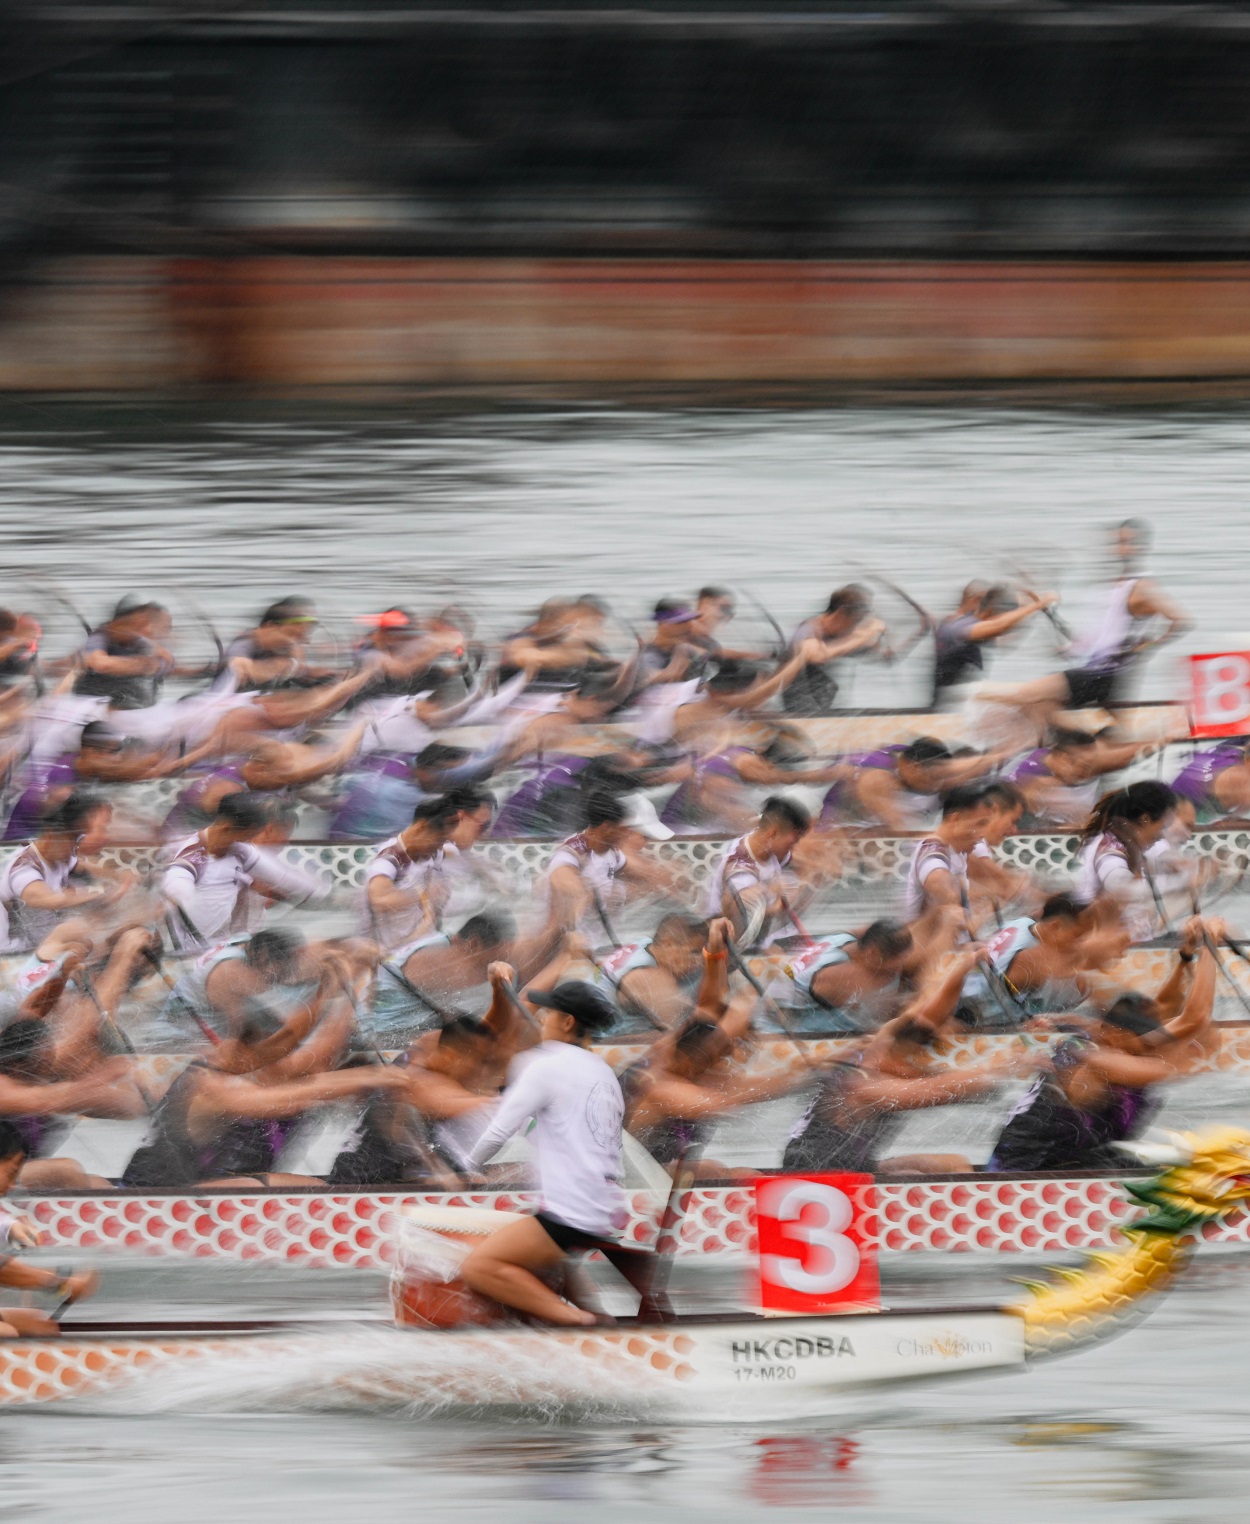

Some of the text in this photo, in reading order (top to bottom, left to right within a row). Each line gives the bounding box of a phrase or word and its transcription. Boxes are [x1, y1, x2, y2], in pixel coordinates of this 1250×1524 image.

[772, 1180, 861, 1295] 3
[732, 1332, 993, 1364] HKCDBA Chapion
[733, 1366, 797, 1383] 17-M20
